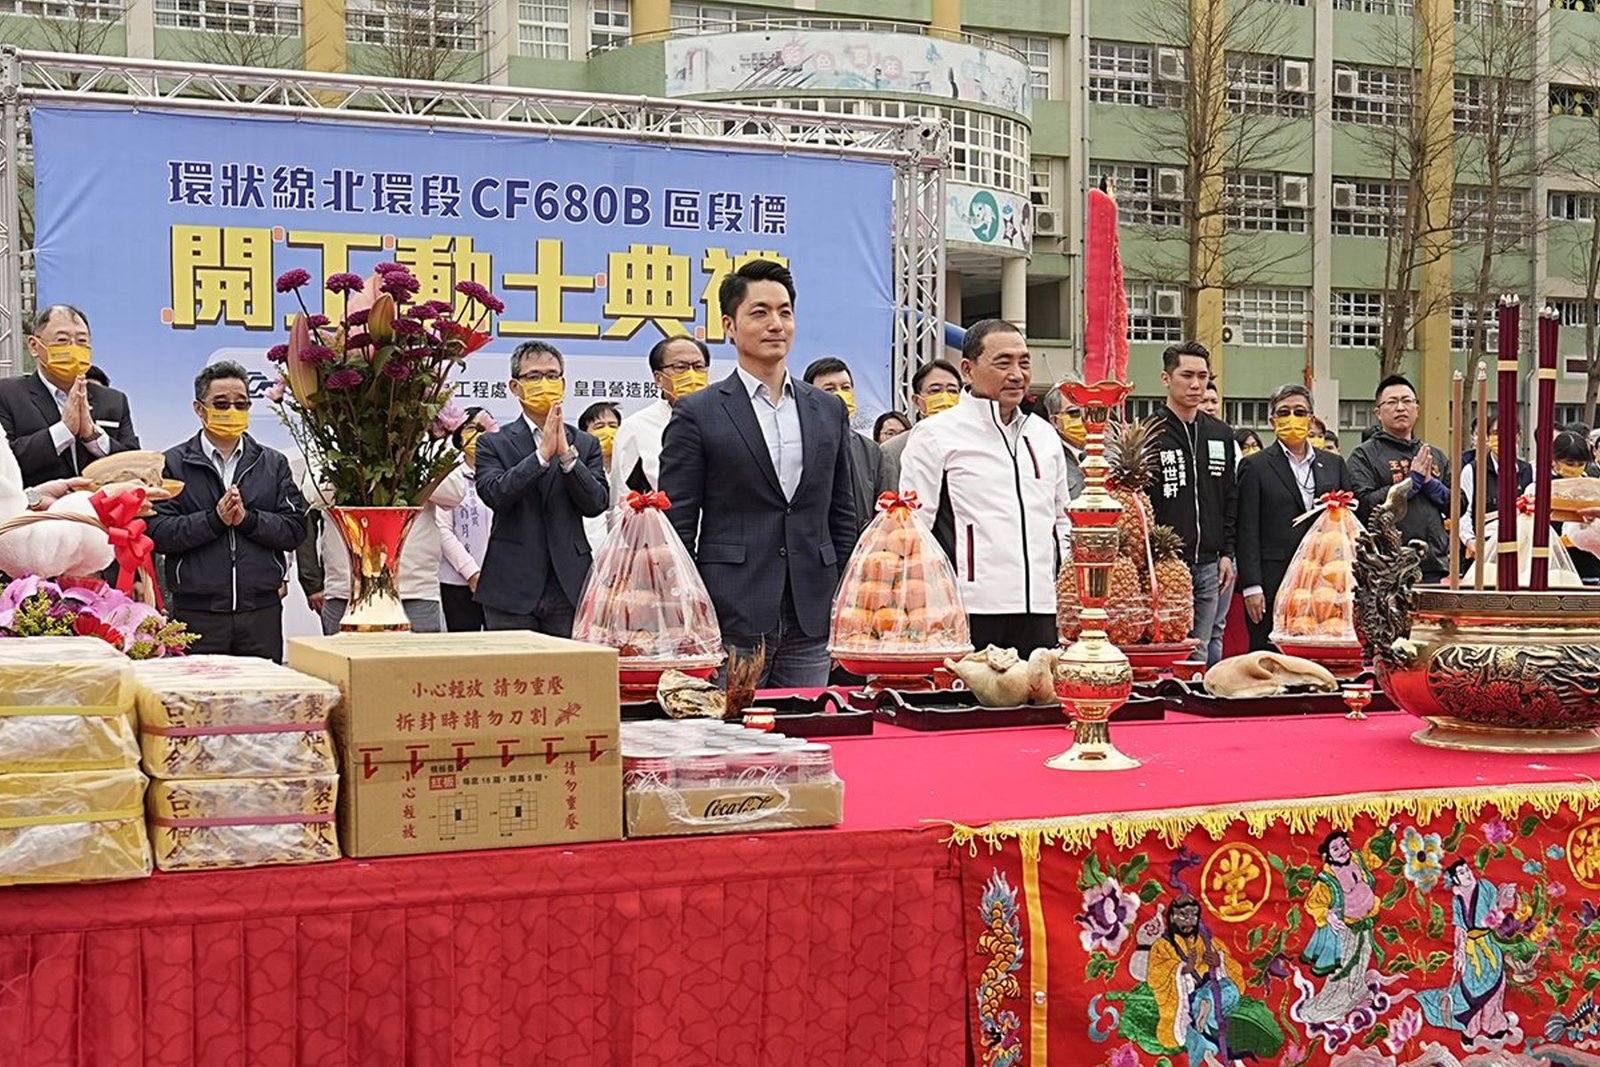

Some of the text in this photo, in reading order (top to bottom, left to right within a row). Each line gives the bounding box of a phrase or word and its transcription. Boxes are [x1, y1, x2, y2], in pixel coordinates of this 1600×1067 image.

[574, 381, 659, 398] 皇昌營造股
[1160, 450, 1178, 498] 陳世軒
[412, 675, 564, 699] 小心輕放 請勿重壓
[395, 706, 547, 732] 拆封時請勿刀割
[1213, 849, 1260, 915] 堂
